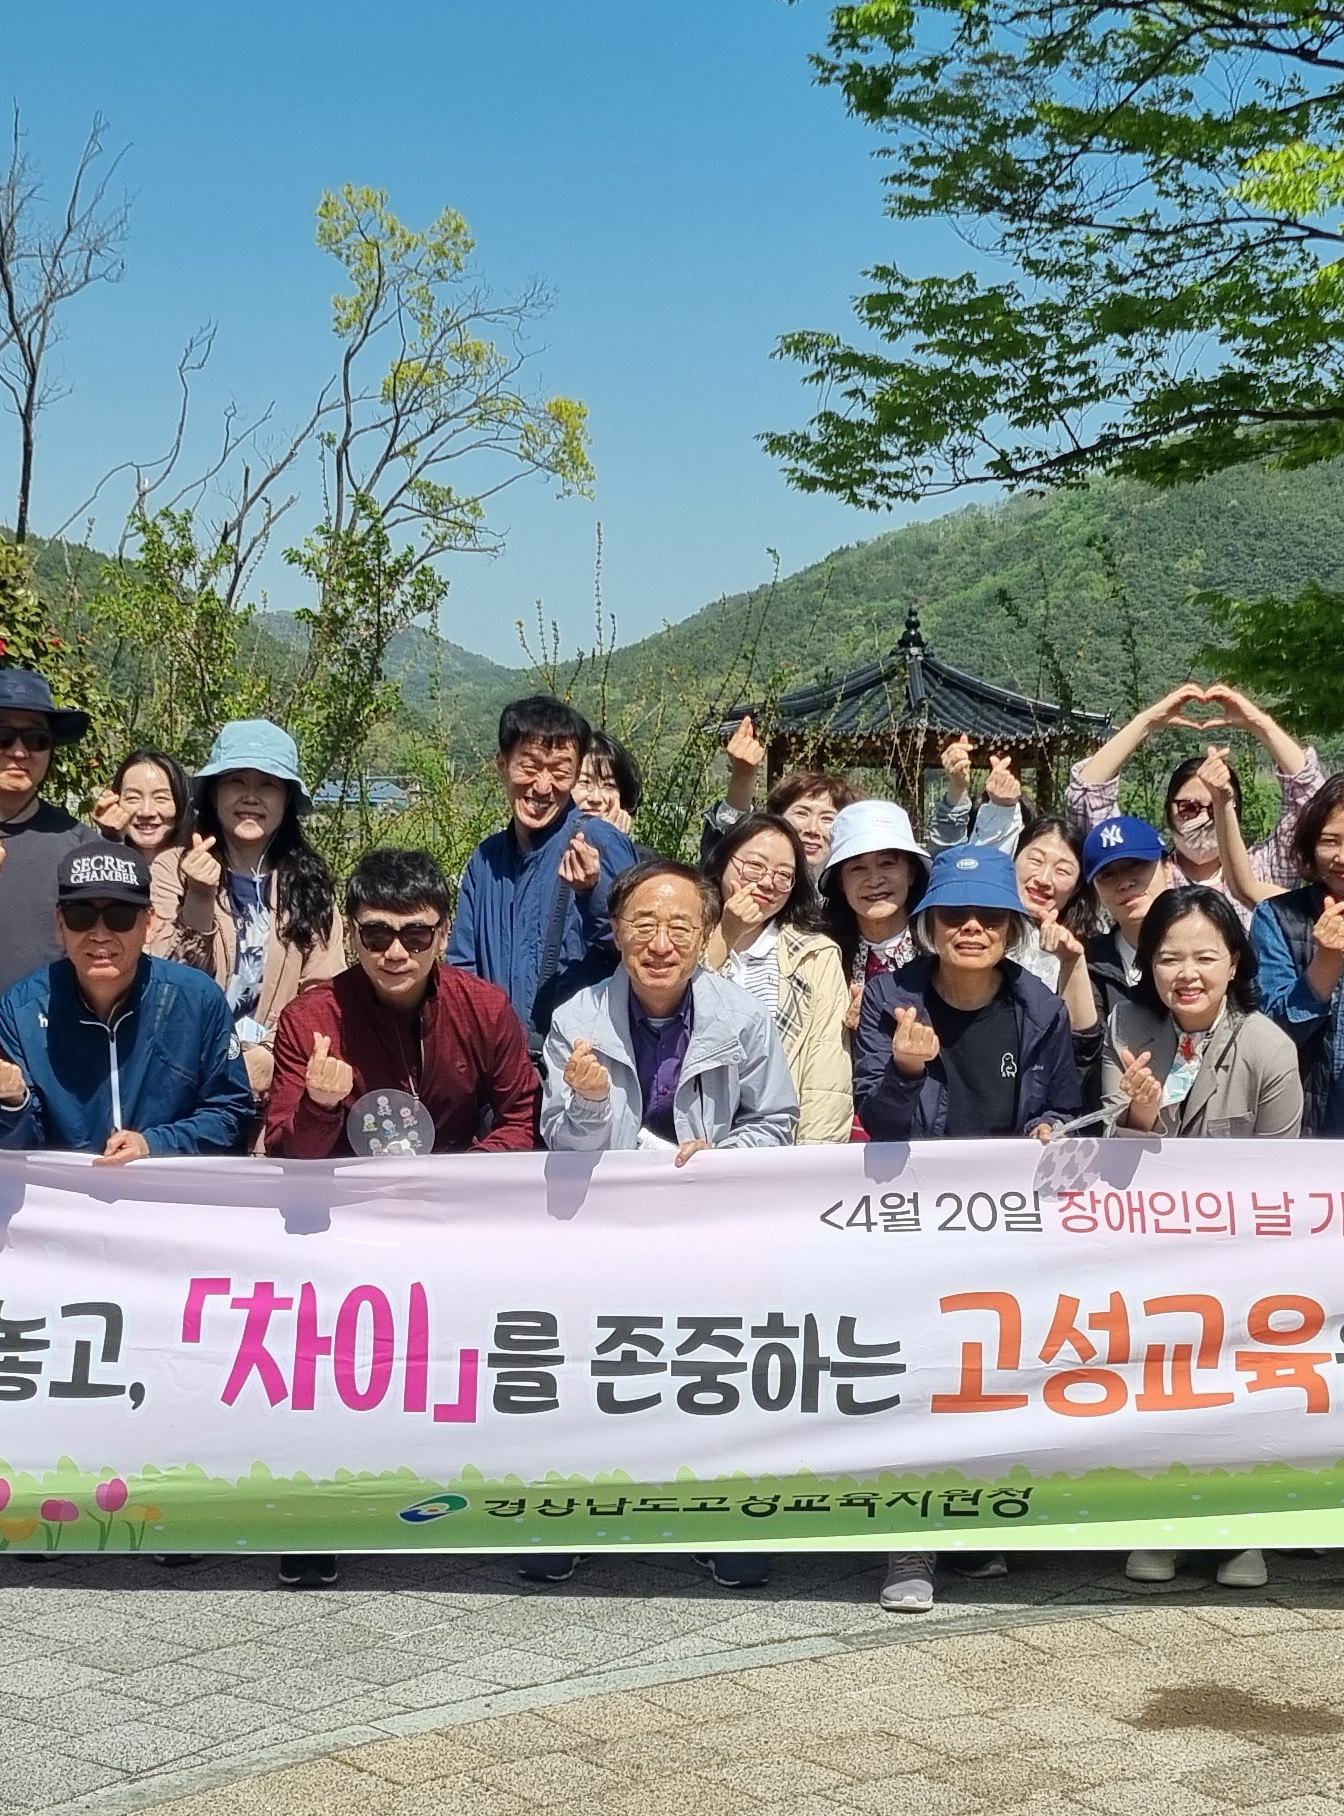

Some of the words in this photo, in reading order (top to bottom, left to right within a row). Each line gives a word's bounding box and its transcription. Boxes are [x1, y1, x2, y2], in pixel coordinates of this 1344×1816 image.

[1100, 824, 1124, 848] NY
[71, 855, 136, 874] SECRET
[70, 869, 140, 886] CHAMBER
[820, 1191, 922, 1233] <4월
[936, 1190, 1043, 1233] 20일
[1058, 1191, 1236, 1236] 장애인의
[1251, 1191, 1295, 1236] 날
[181, 1277, 565, 1423] 「차이」를
[590, 1312, 907, 1416] 존중하는
